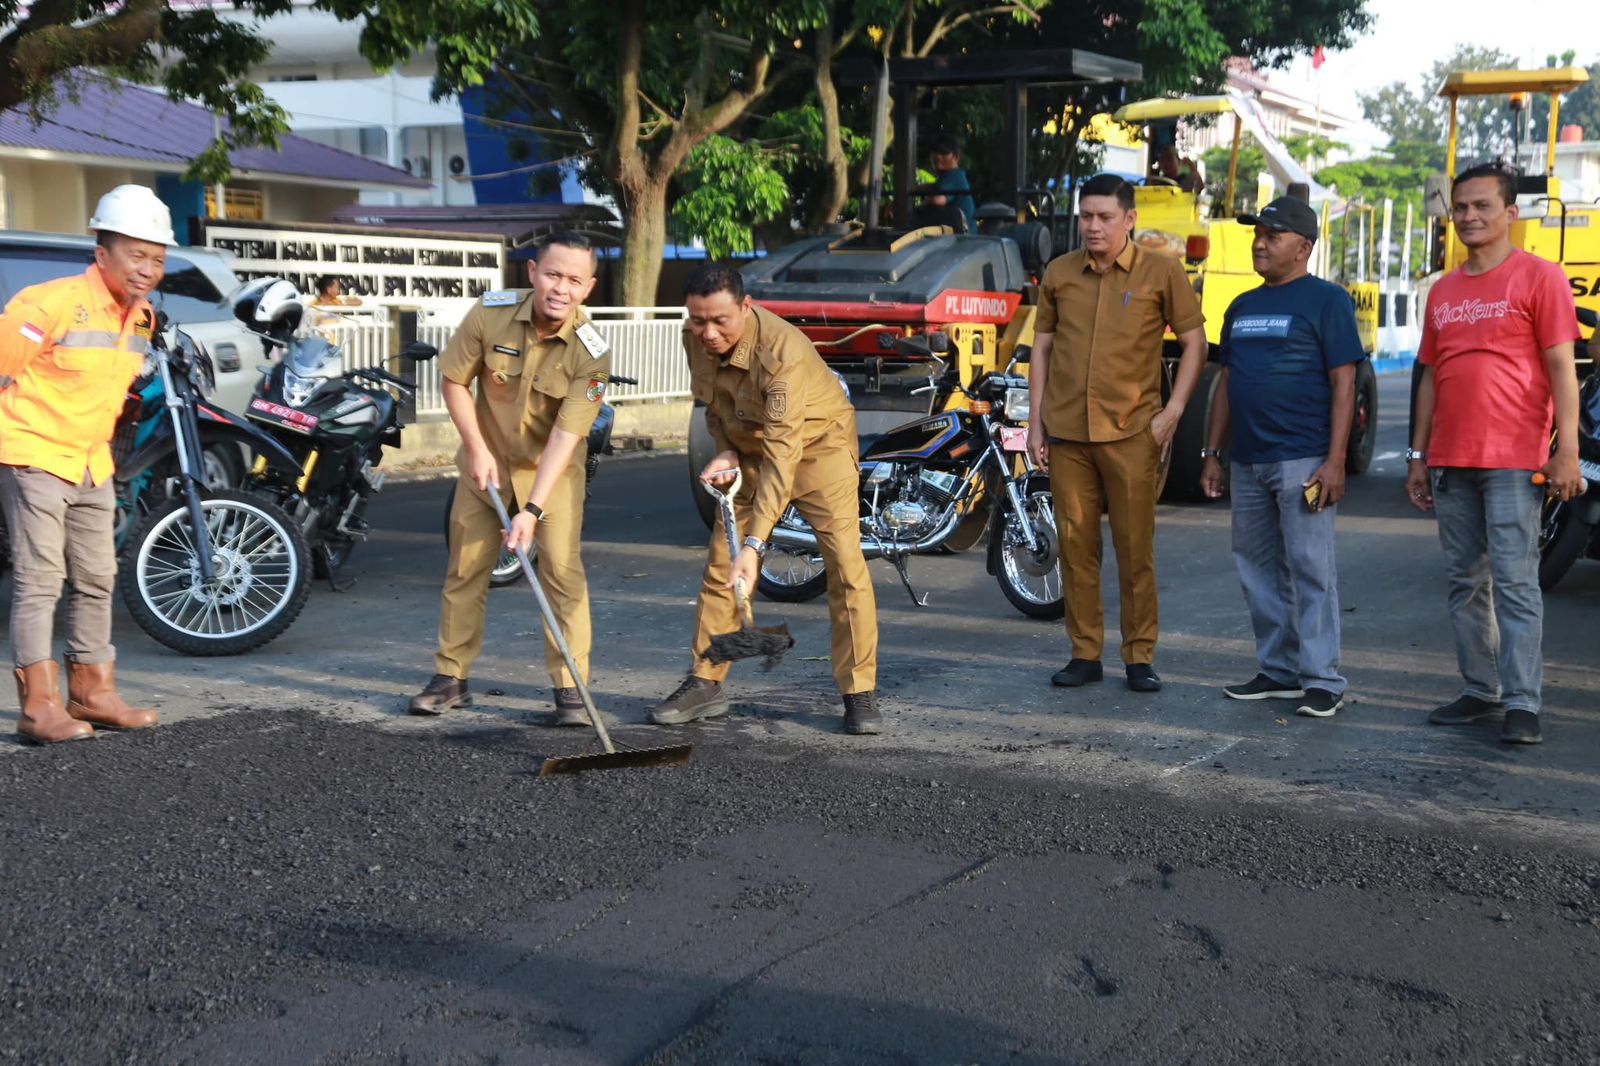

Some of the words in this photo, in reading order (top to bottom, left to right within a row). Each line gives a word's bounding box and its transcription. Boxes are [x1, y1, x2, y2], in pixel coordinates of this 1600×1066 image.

[384, 275, 407, 297] BPN
[412, 277, 463, 298] PROVINSI
[945, 295, 959, 315] PT.
[961, 296, 1008, 318] LUTVINDO
